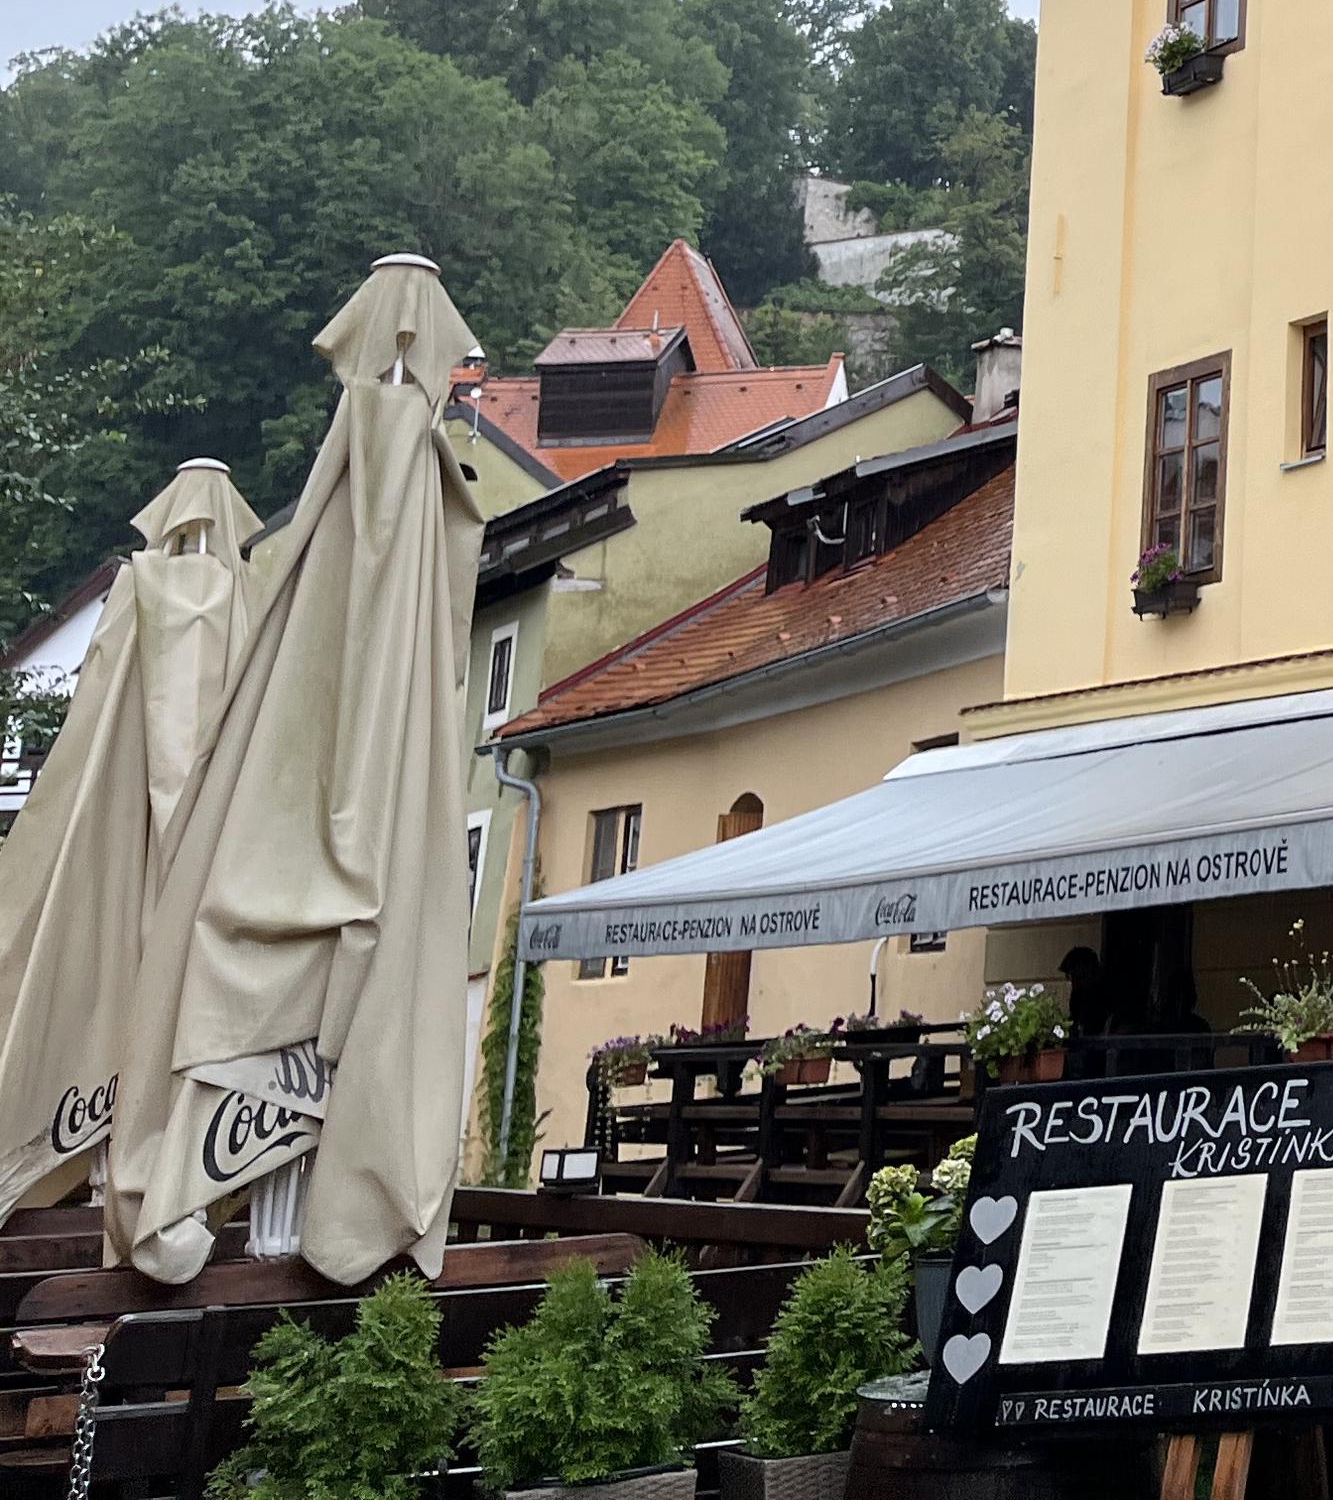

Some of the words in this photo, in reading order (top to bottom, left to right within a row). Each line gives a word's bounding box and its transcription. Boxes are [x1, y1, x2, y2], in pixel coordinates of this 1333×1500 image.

[968, 861, 1162, 912] RESTAURACE-PENZION
[1166, 858, 1192, 888] NA
[1197, 838, 1289, 881] OSTROVĚ
[740, 914, 756, 936] NA
[760, 902, 821, 935] OSTROVĚ
[1006, 1079, 1311, 1158] RESTAURACE
[1034, 1395, 1154, 1421] RESTAURACE
[1193, 1380, 1311, 1414] KRISTÍNKA
